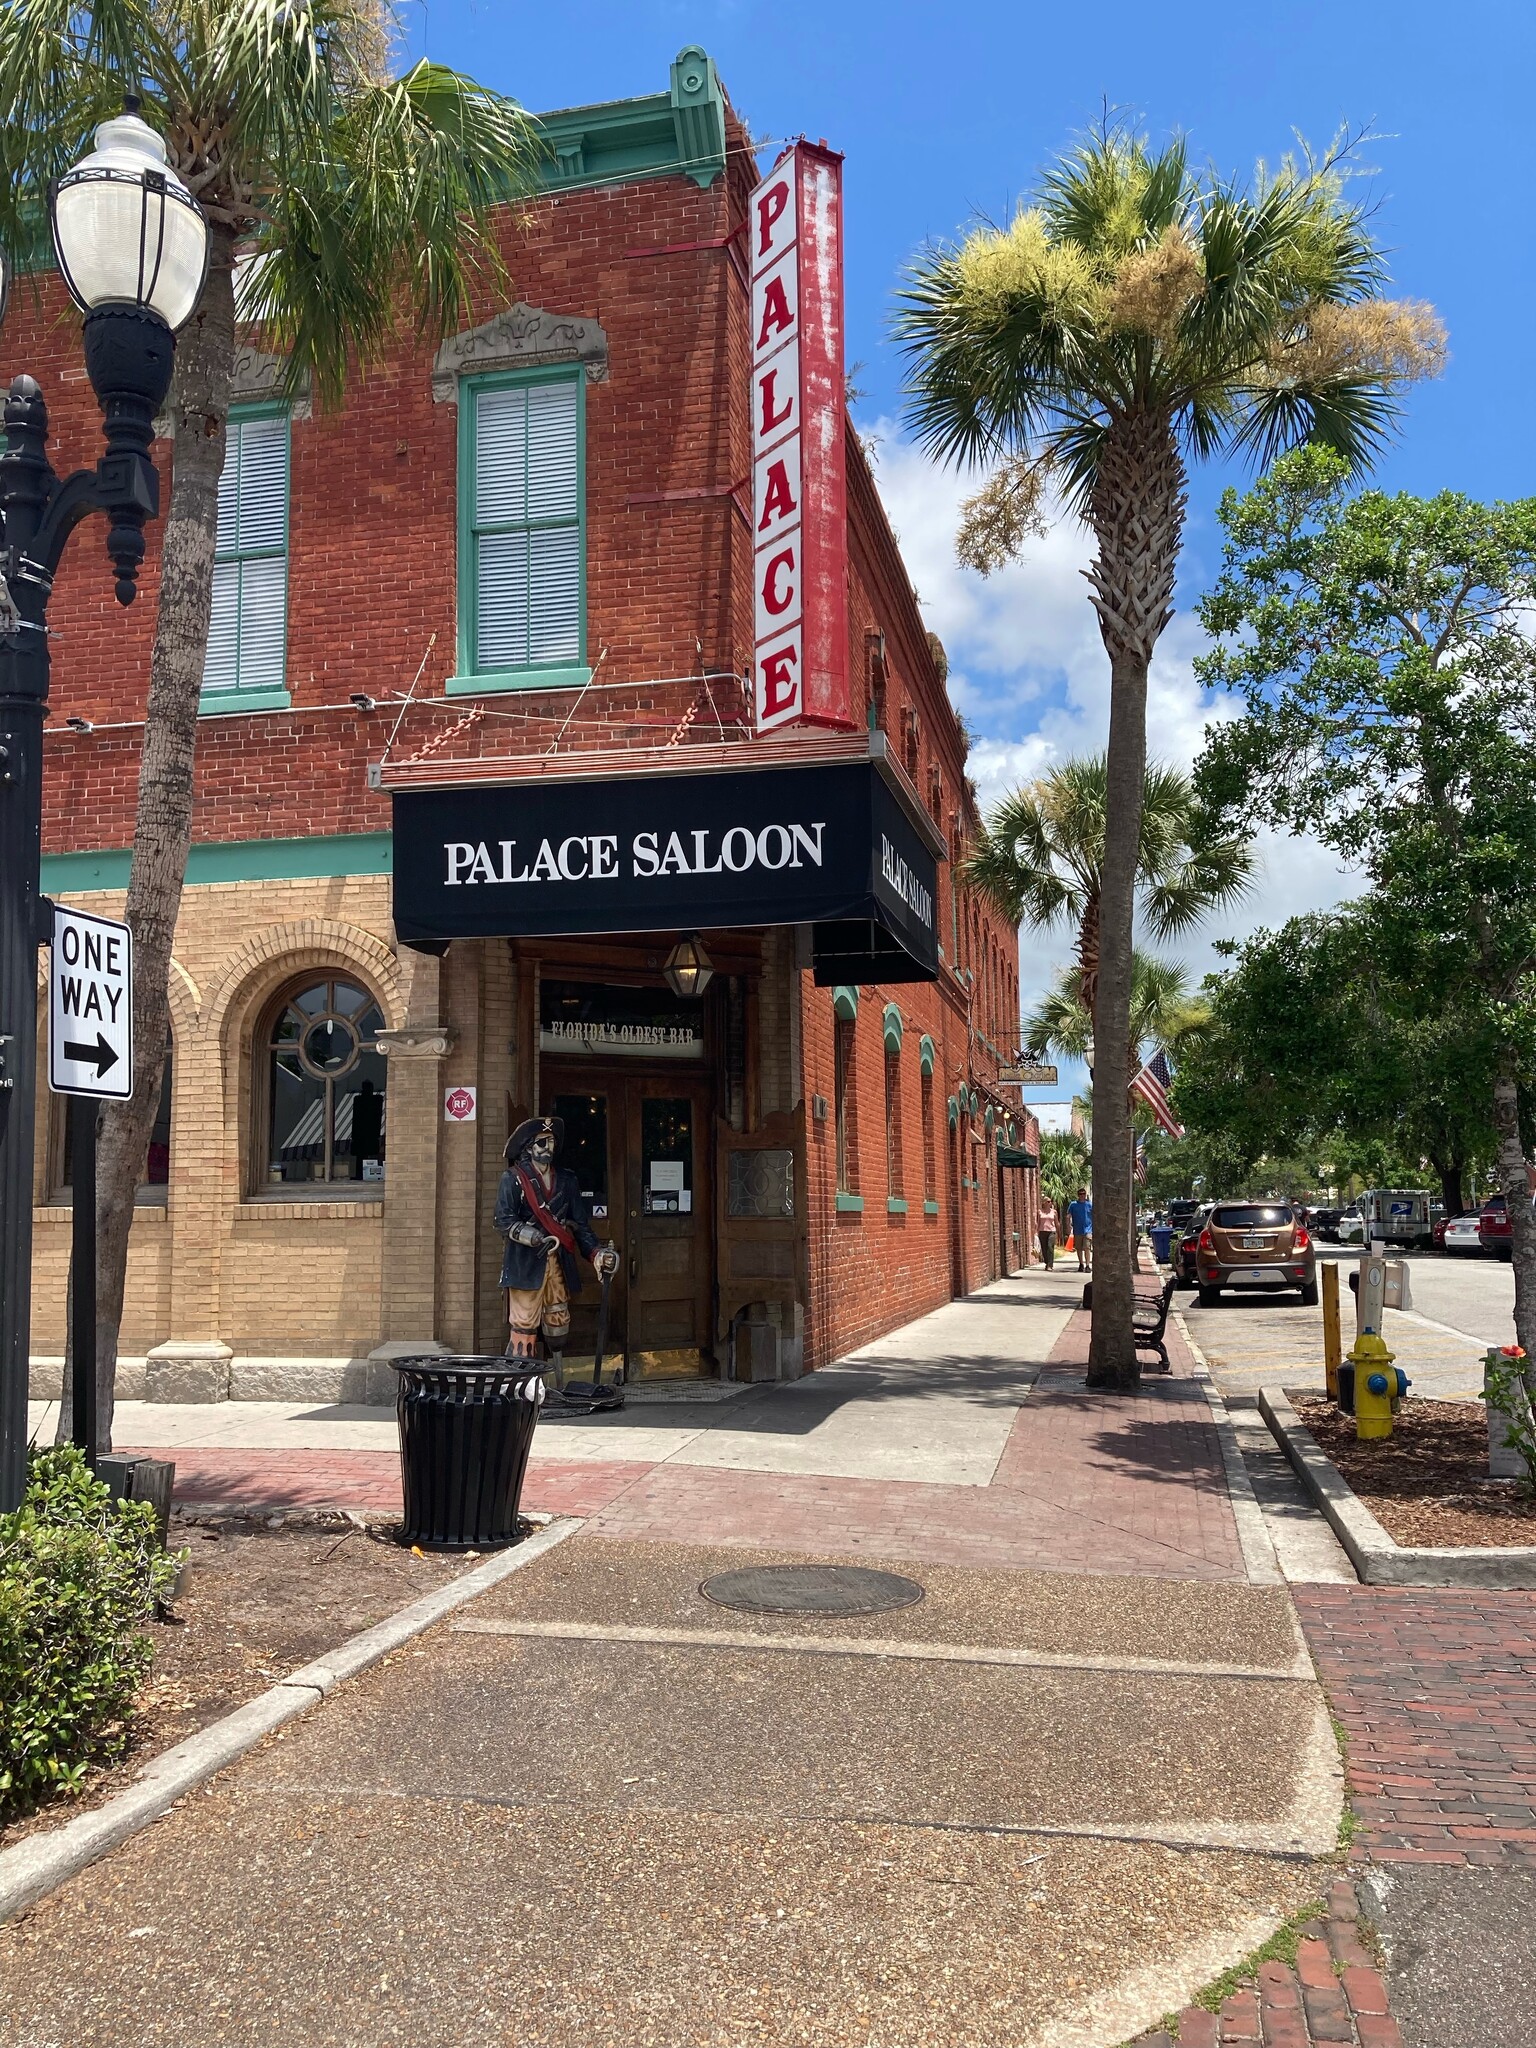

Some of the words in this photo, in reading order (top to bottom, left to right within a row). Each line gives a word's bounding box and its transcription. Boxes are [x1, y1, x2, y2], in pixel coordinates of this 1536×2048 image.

[756, 180, 798, 721] PALACE
[443, 834, 619, 885] PALACE
[632, 822, 826, 878] SALOON
[881, 832, 909, 904] PALACE
[908, 869, 932, 931] SALOON
[63, 926, 122, 976] ONE
[60, 975, 123, 1023] WAY
[551, 1020, 617, 1043] FLORIDA'S
[620, 1024, 666, 1045] OLDEST
[669, 1027, 694, 1046] BAR
[454, 1100, 467, 1109] RF
